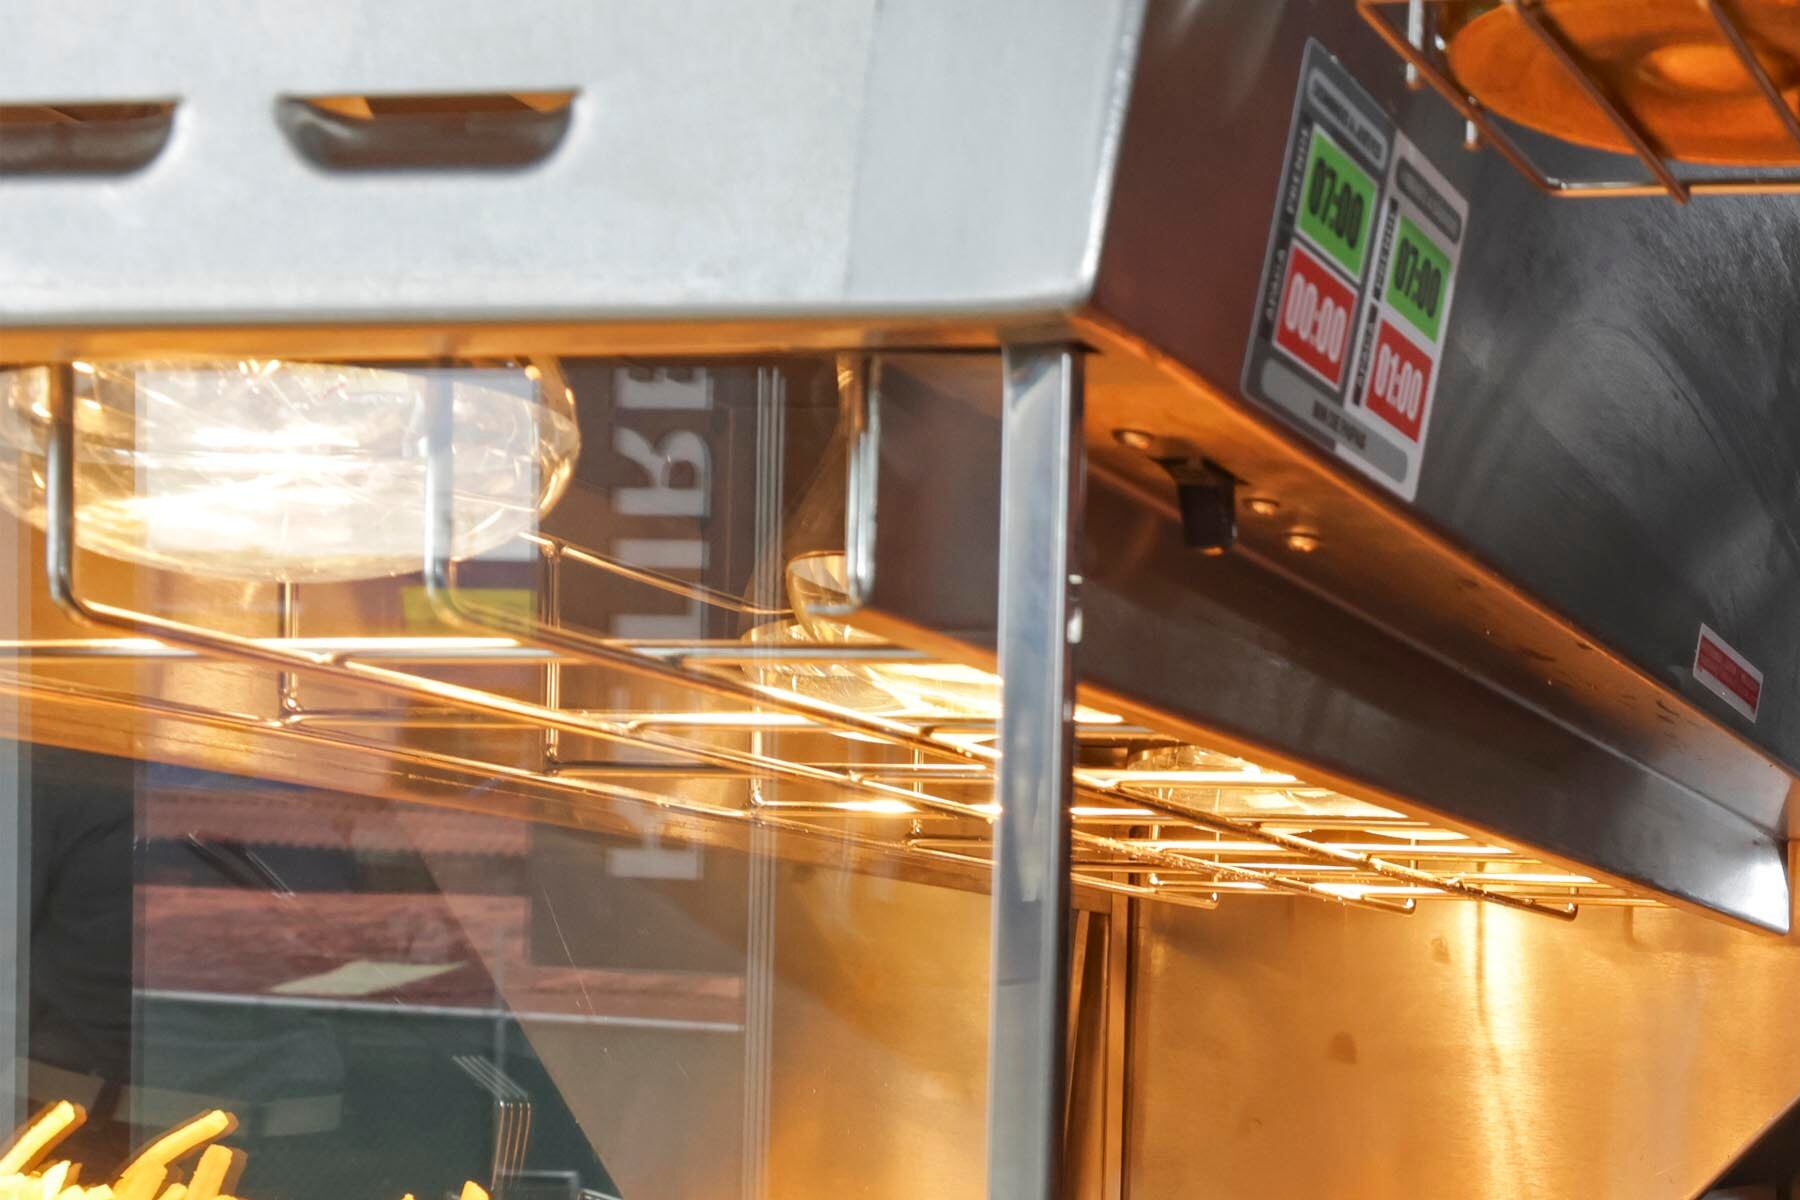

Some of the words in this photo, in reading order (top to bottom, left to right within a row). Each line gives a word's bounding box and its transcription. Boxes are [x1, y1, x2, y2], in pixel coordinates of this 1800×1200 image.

[1307, 154, 1366, 251] 07:00
[1284, 270, 1348, 366] 00:00
[1393, 234, 1442, 320] 07:00
[1372, 341, 1425, 422] 01:00
